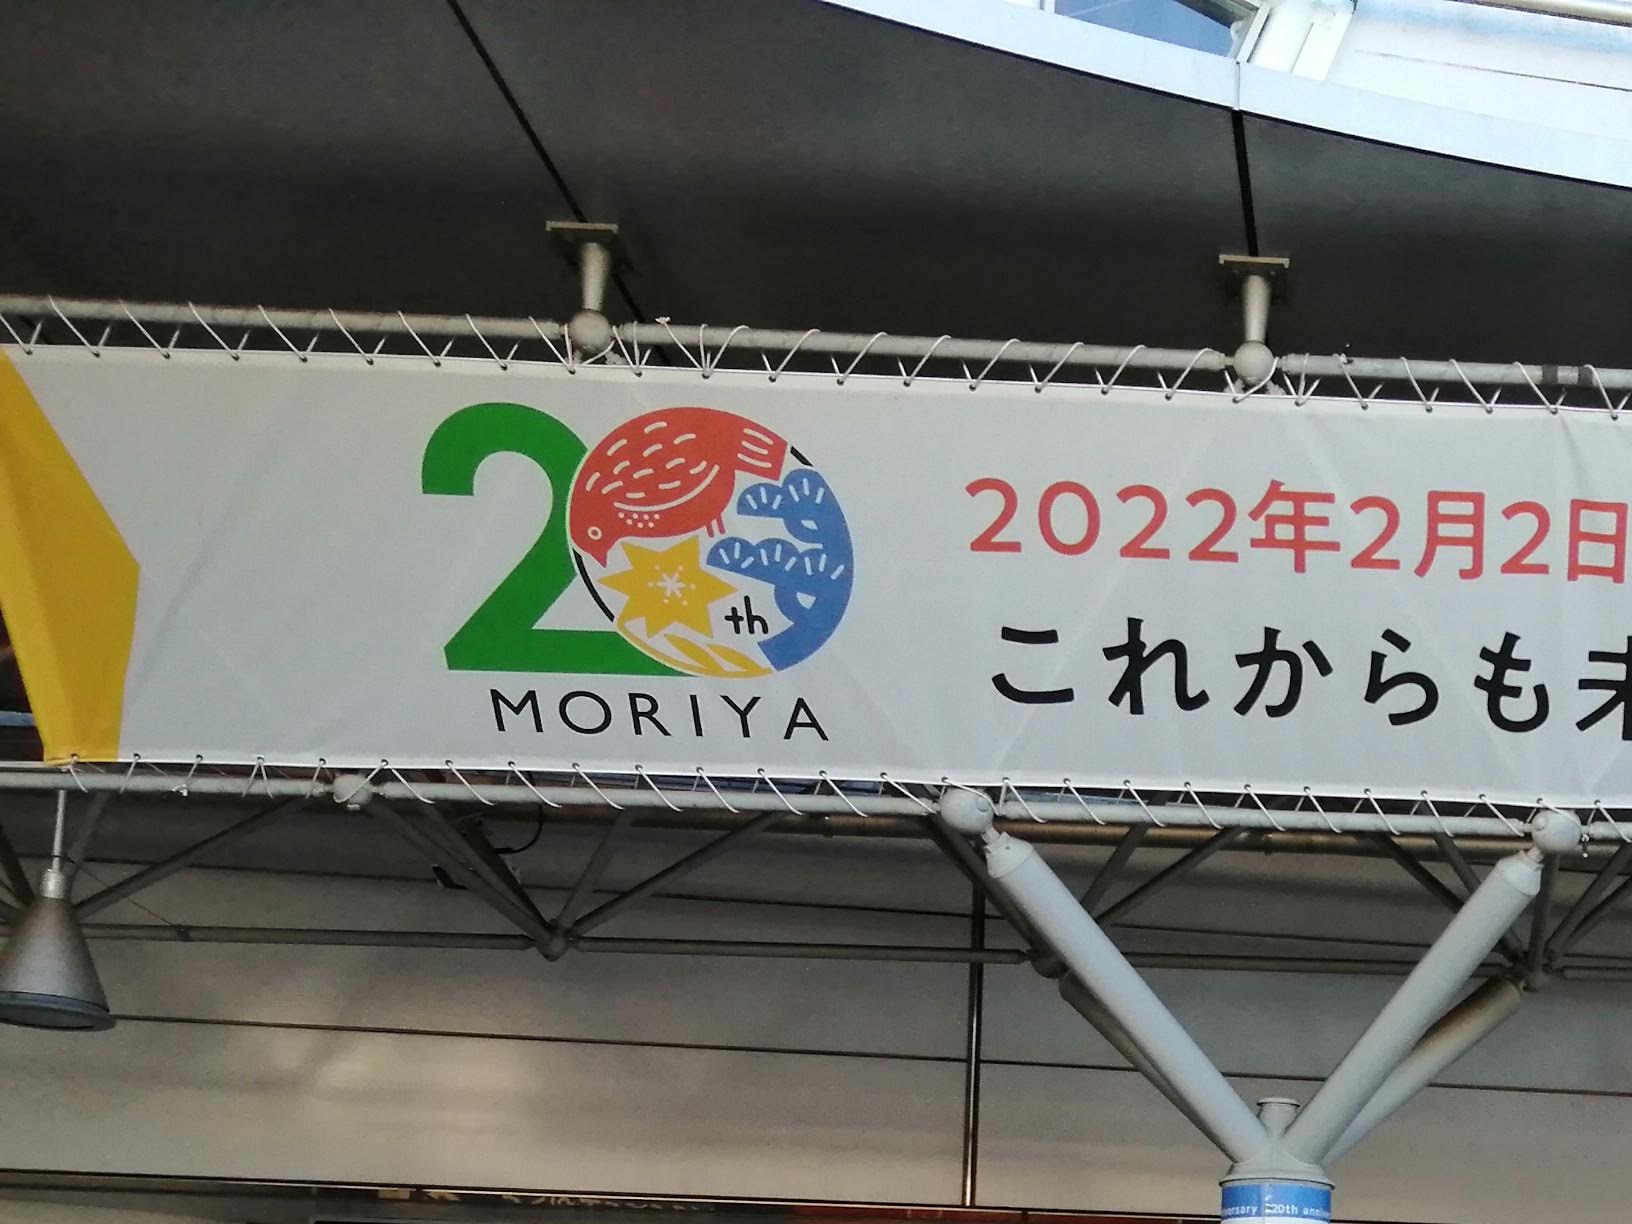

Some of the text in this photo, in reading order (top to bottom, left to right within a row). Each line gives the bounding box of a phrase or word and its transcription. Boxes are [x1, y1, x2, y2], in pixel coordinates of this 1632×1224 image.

[964, 477, 1629, 584] 2022年2月2日
[489, 687, 830, 742] MORIYA
